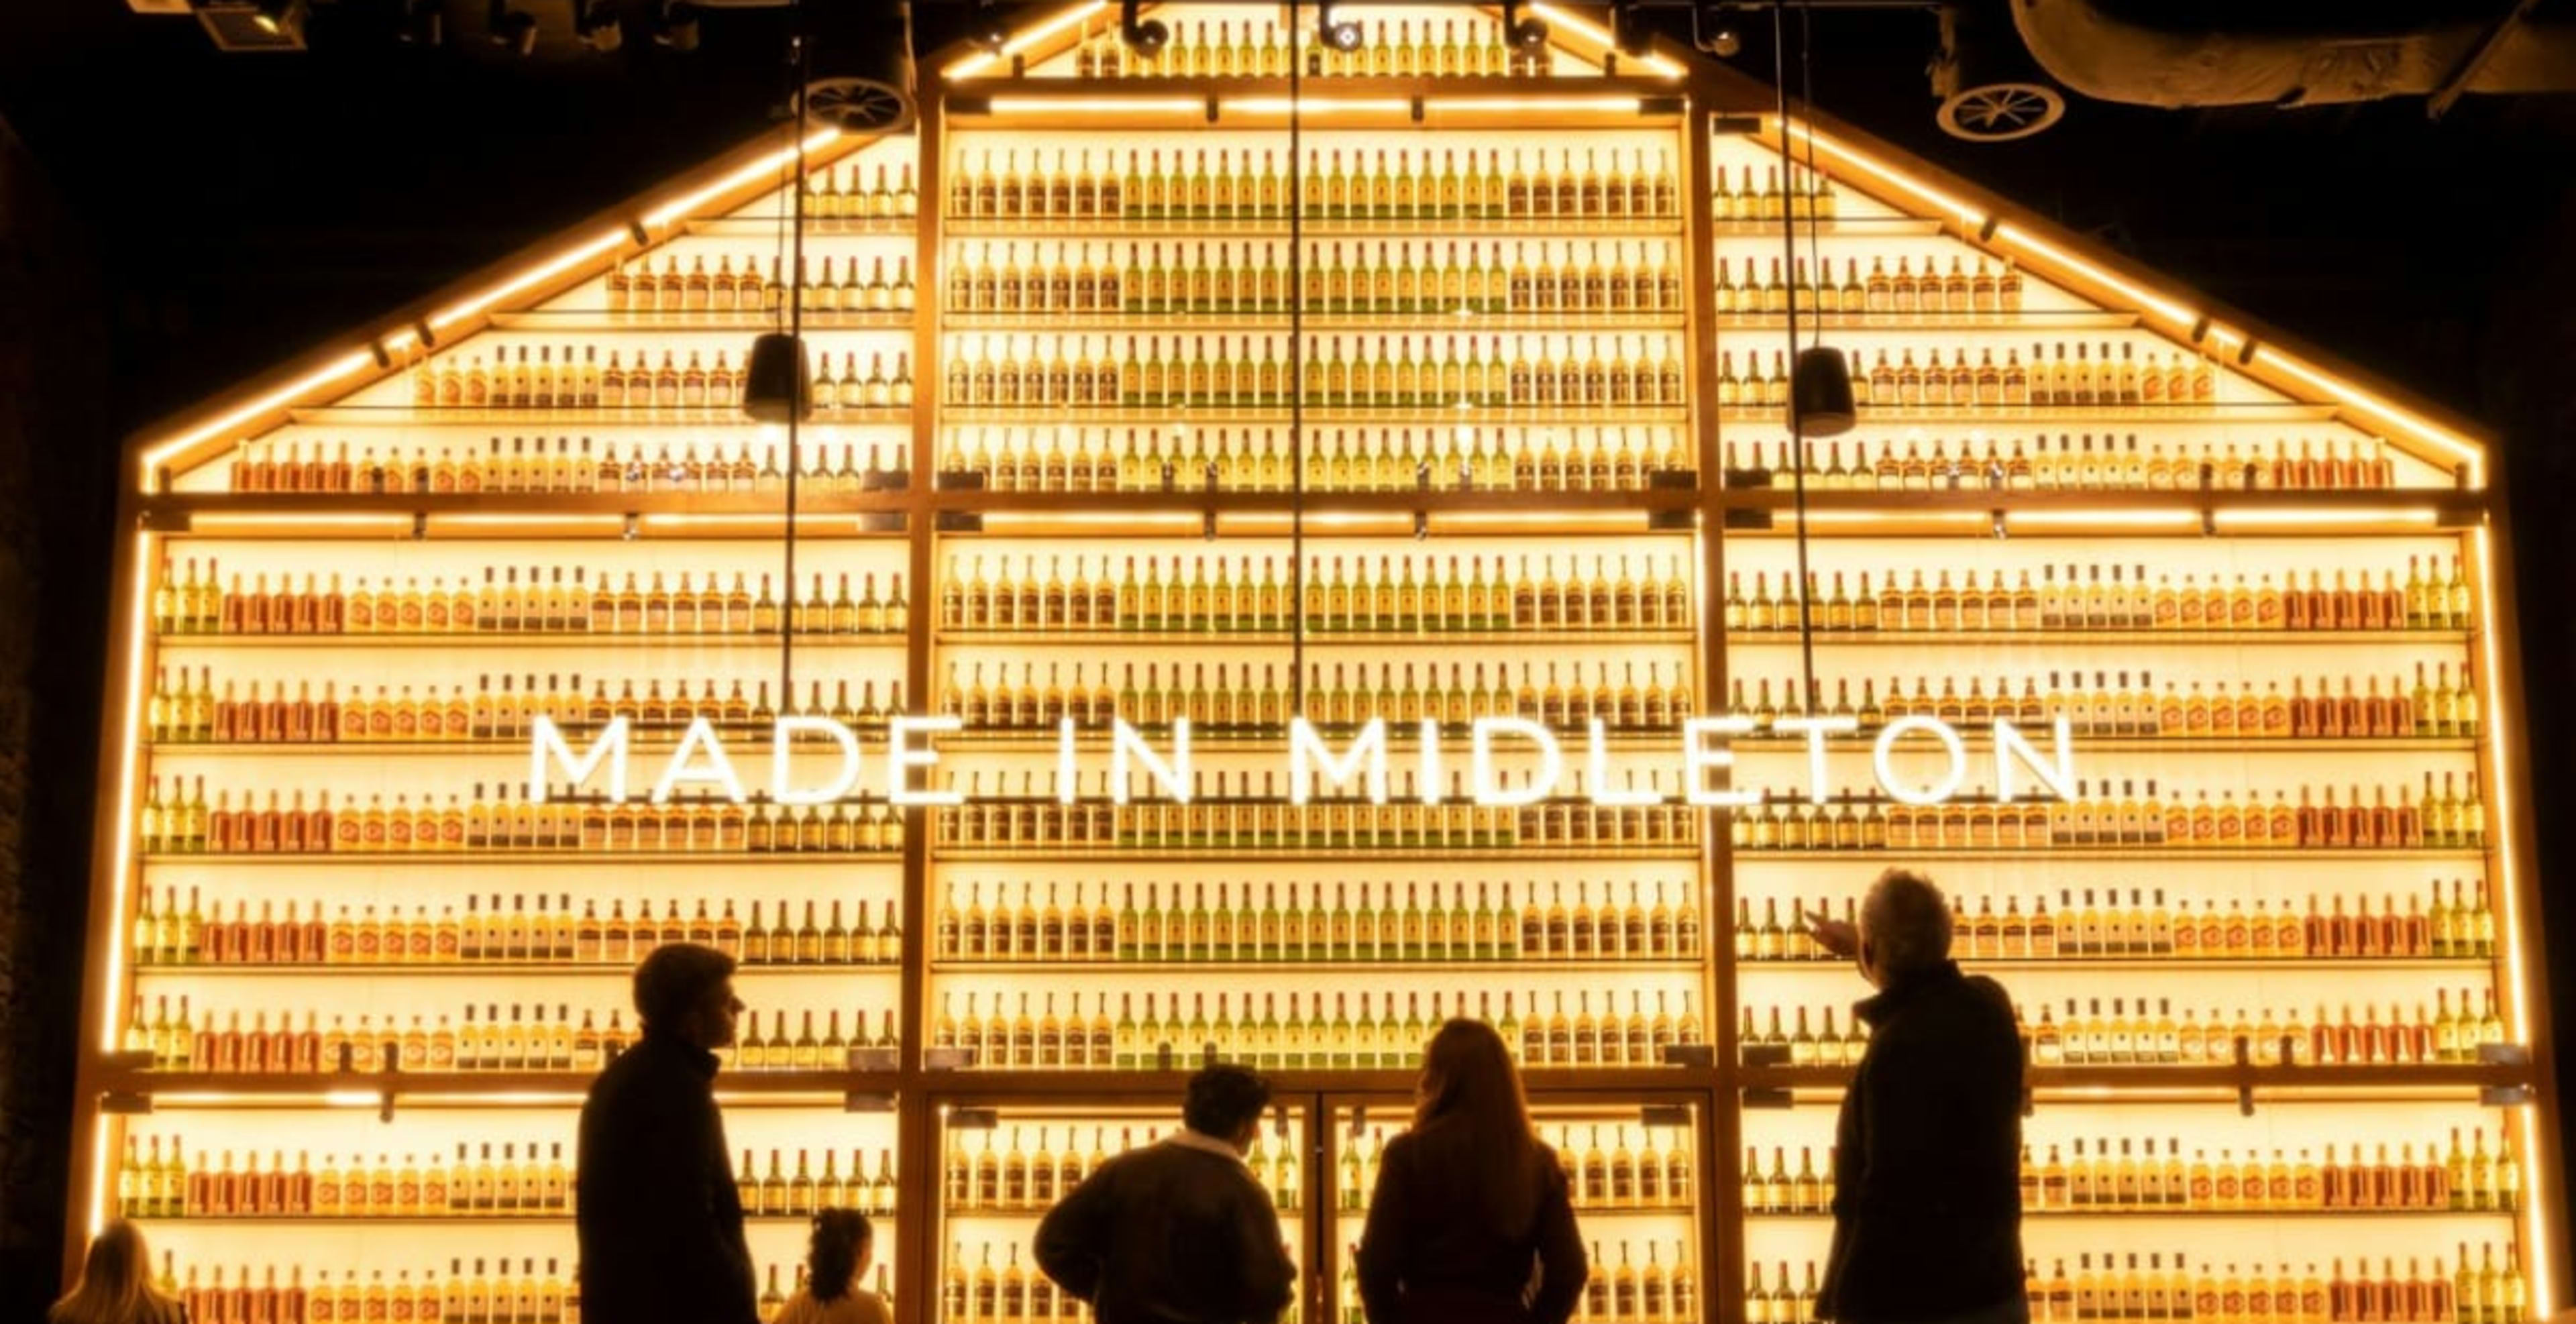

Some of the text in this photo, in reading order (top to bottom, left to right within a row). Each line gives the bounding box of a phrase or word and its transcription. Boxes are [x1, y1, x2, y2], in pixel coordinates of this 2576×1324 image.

[529, 715, 2079, 805] MADE IN MIDLETON
